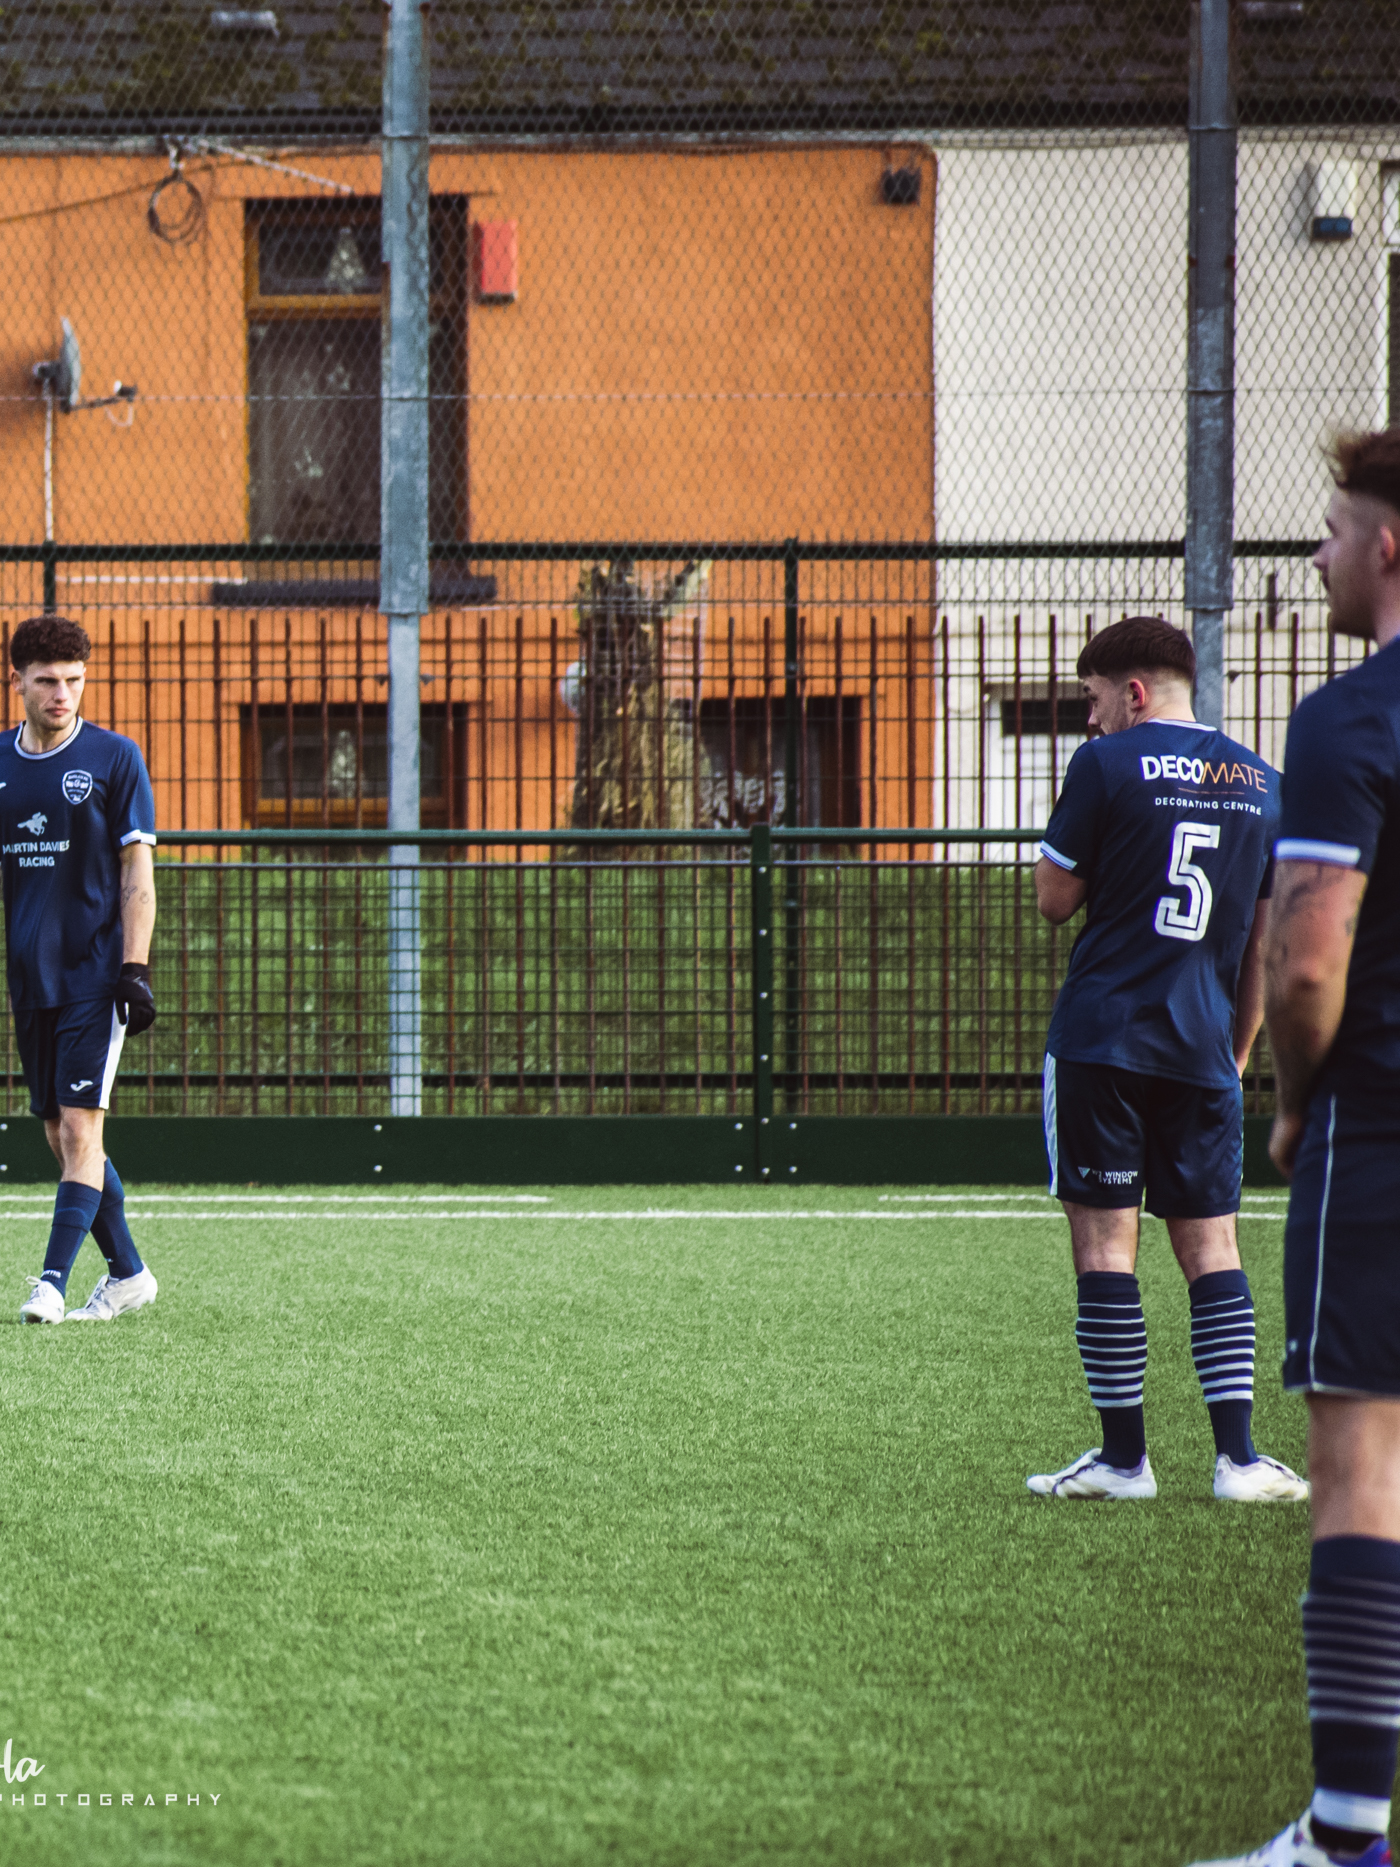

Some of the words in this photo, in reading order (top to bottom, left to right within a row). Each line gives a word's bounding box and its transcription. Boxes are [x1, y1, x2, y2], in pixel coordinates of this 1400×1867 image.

[1141, 754, 1268, 794] DECOMATE
[1155, 797, 1219, 810] DECORATING
[1223, 801, 1262, 816] CENTRE
[40, 840, 69, 852] DAVIES
[19, 856, 55, 867] RACING
[1154, 821, 1221, 942] 5
